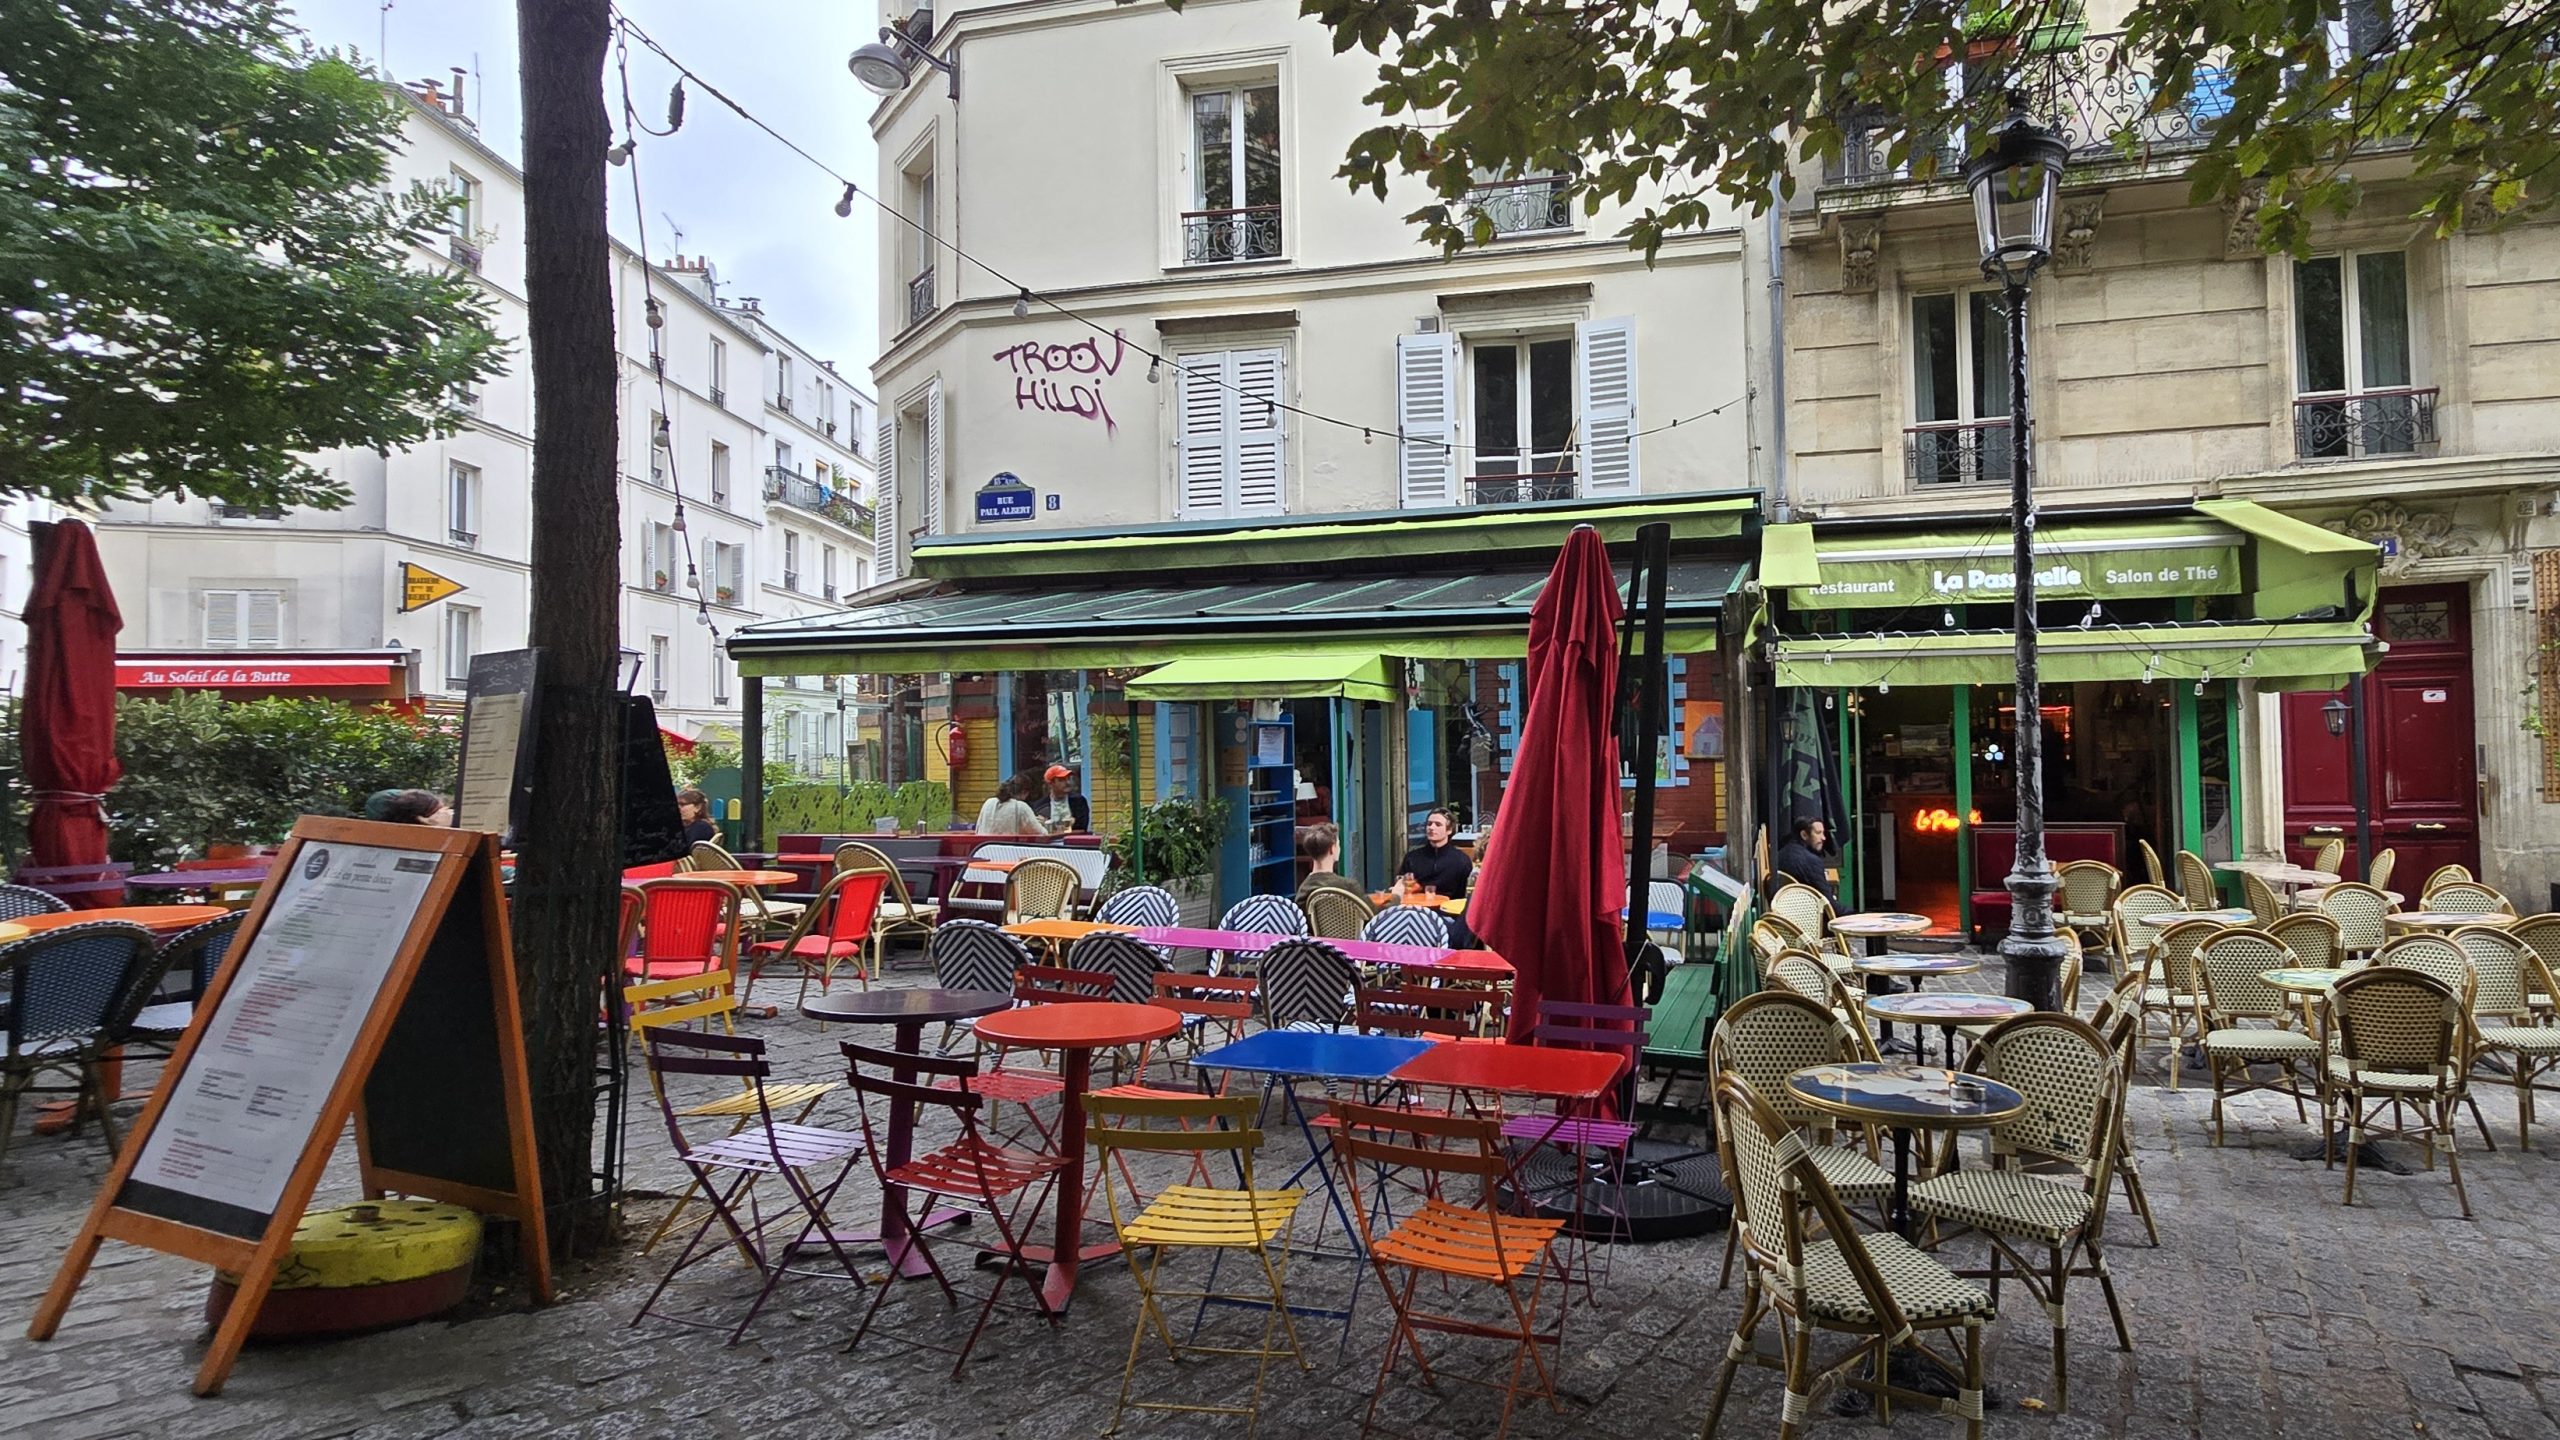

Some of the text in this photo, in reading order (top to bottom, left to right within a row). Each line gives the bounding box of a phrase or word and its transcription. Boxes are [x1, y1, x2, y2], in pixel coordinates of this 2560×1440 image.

[997, 496, 1014, 505] RUE
[1048, 495, 1057, 509] 8
[980, 506, 1031, 516] PAUL ALBERT
[1933, 565, 2081, 594] La Passrelle
[2106, 564, 2218, 584] Salon de Thé
[139, 670, 290, 683] Au Soleil de la Butte
